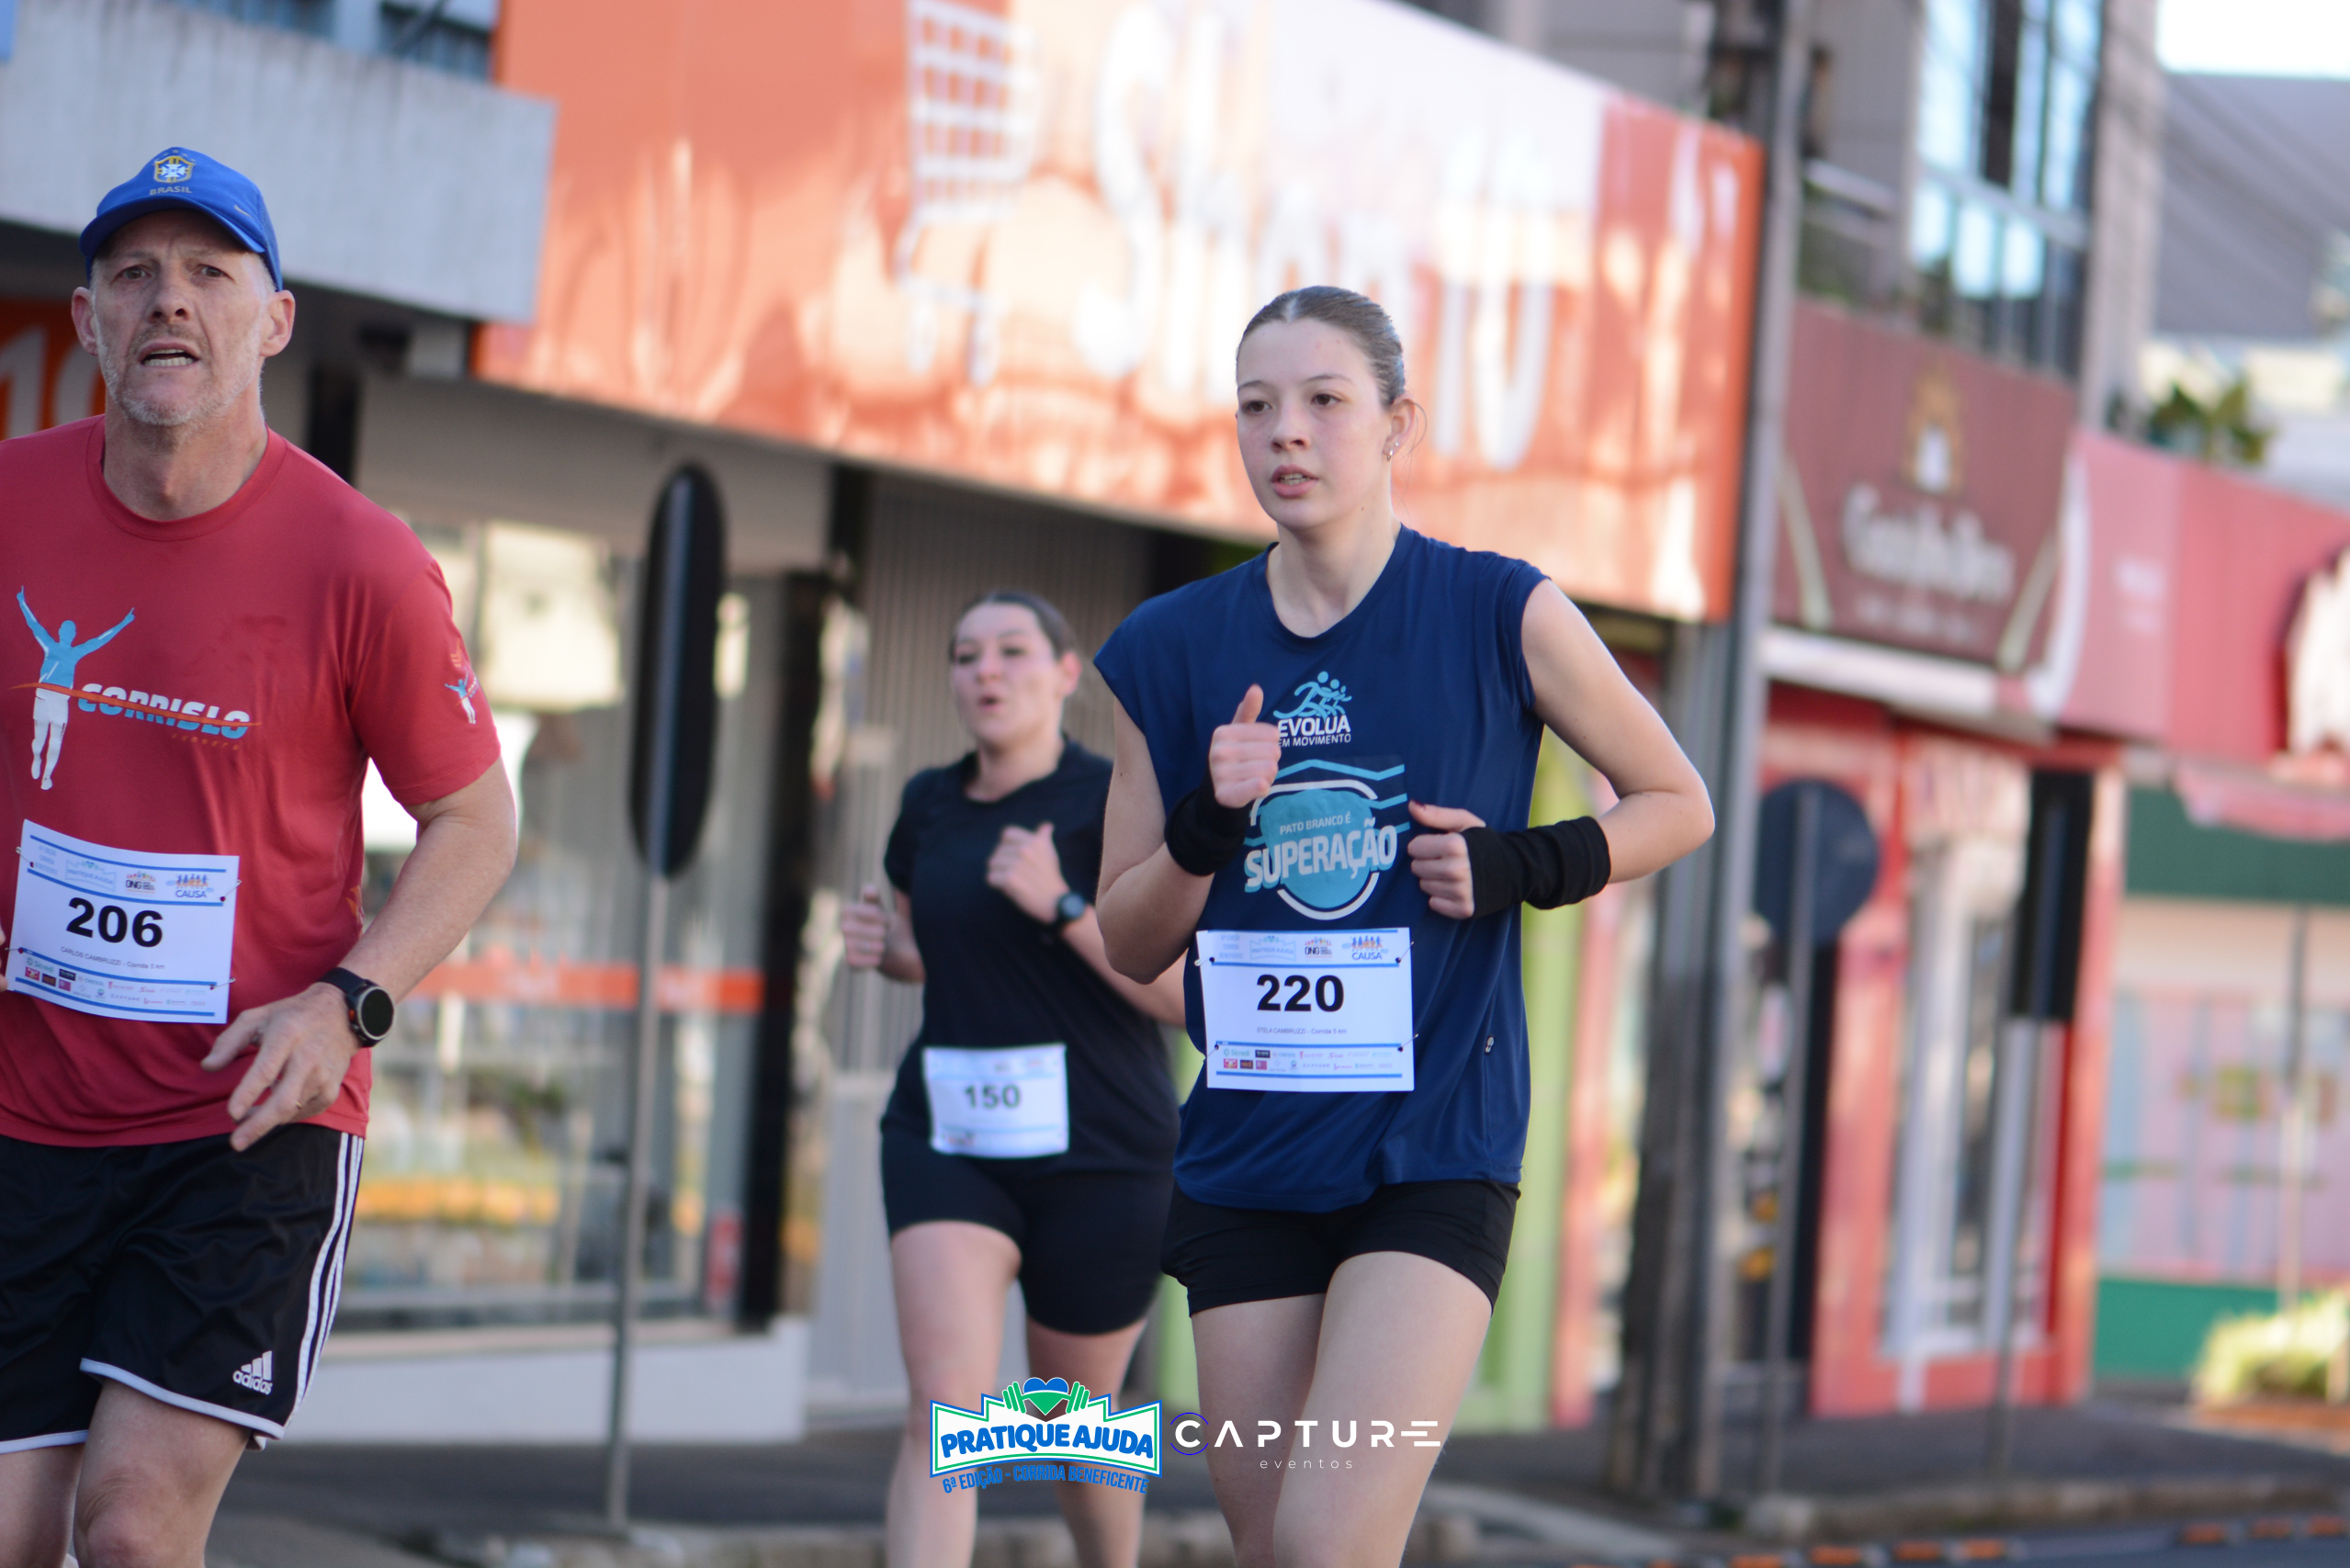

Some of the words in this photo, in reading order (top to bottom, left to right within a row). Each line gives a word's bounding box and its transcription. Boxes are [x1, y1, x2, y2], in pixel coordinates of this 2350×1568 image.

[149, 186, 192, 196] BRASIL
[1278, 714, 1351, 737] EVOLUA
[1293, 733, 1351, 747] MOVIMENTO
[1280, 823, 1305, 836] PATO
[1305, 816, 1343, 831] BRANCO
[1345, 811, 1351, 824] É
[1246, 817, 1398, 891] SUPERAÇÃO
[126, 879, 141, 890] ONG
[175, 889, 207, 898] CAUSA
[66, 897, 164, 947] 206
[61, 946, 84, 958] CARLOS
[127, 961, 149, 969] Corrida
[1305, 946, 1319, 955] ONG
[1352, 952, 1383, 960] CAUSA
[1257, 974, 1345, 1012] 220
[965, 1084, 1022, 1110] 150
[232, 1370, 273, 1395] adidas
